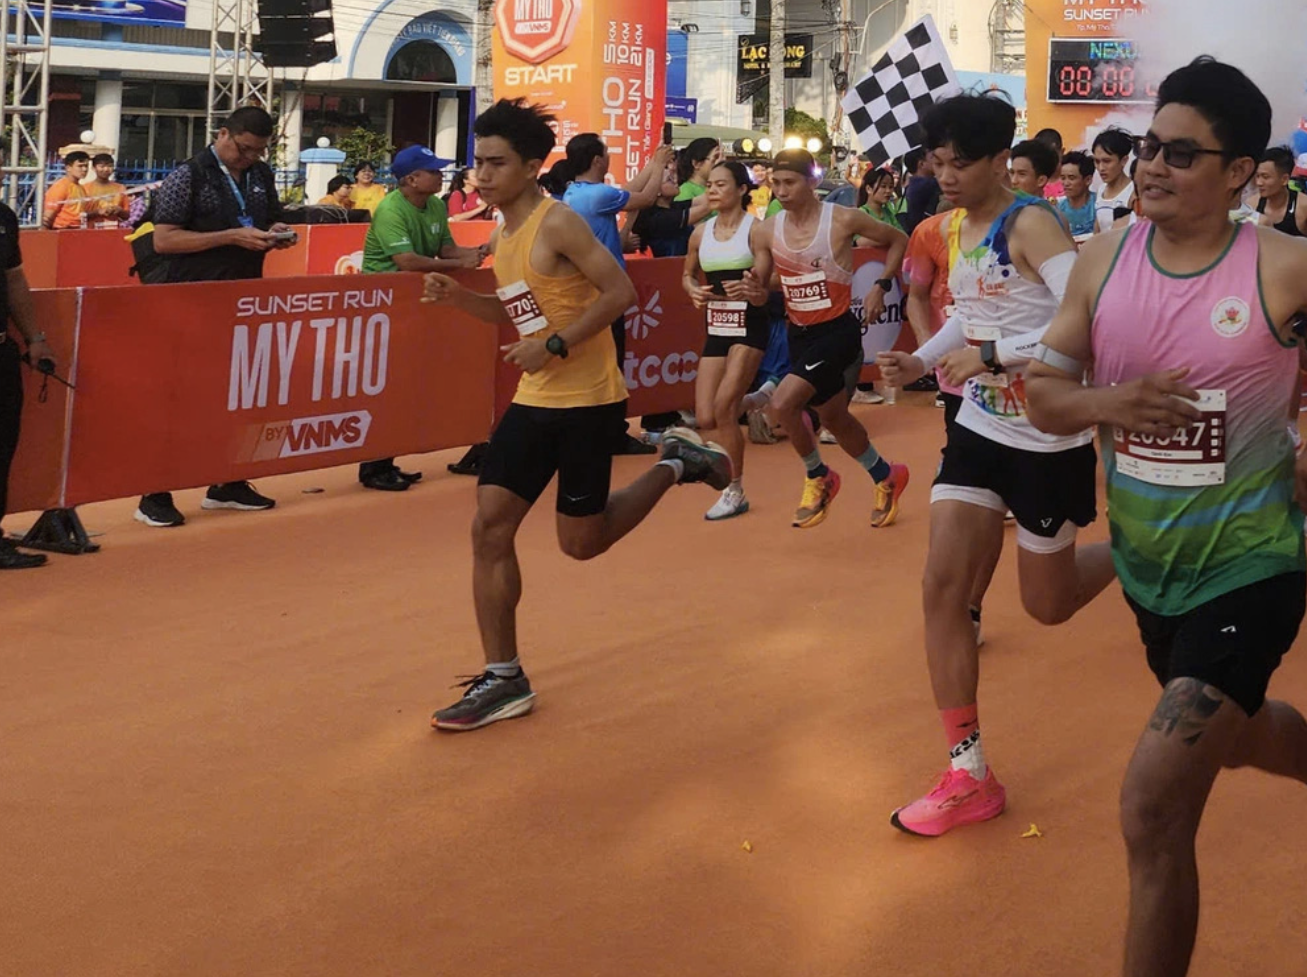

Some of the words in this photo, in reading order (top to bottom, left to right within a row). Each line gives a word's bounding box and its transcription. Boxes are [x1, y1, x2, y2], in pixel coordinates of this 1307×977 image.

[1063, 8, 1121, 21] SUNSET
[608, 21, 617, 42] KM
[621, 22, 630, 43] KM
[635, 24, 643, 45] KM
[603, 43, 616, 64] 5
[617, 45, 629, 65] 10
[630, 46, 642, 66] 21
[741, 46, 767, 62] LẠC
[504, 63, 578, 86] START
[627, 79, 642, 130] RUN
[236, 291, 340, 317] SUNSET
[343, 288, 393, 310] RUN
[788, 286, 820, 298] 20769
[712, 312, 740, 323] 20598
[227, 320, 302, 412] MY
[309, 312, 390, 402] THO
[265, 426, 284, 442] BY
[286, 415, 361, 452] VNMS
